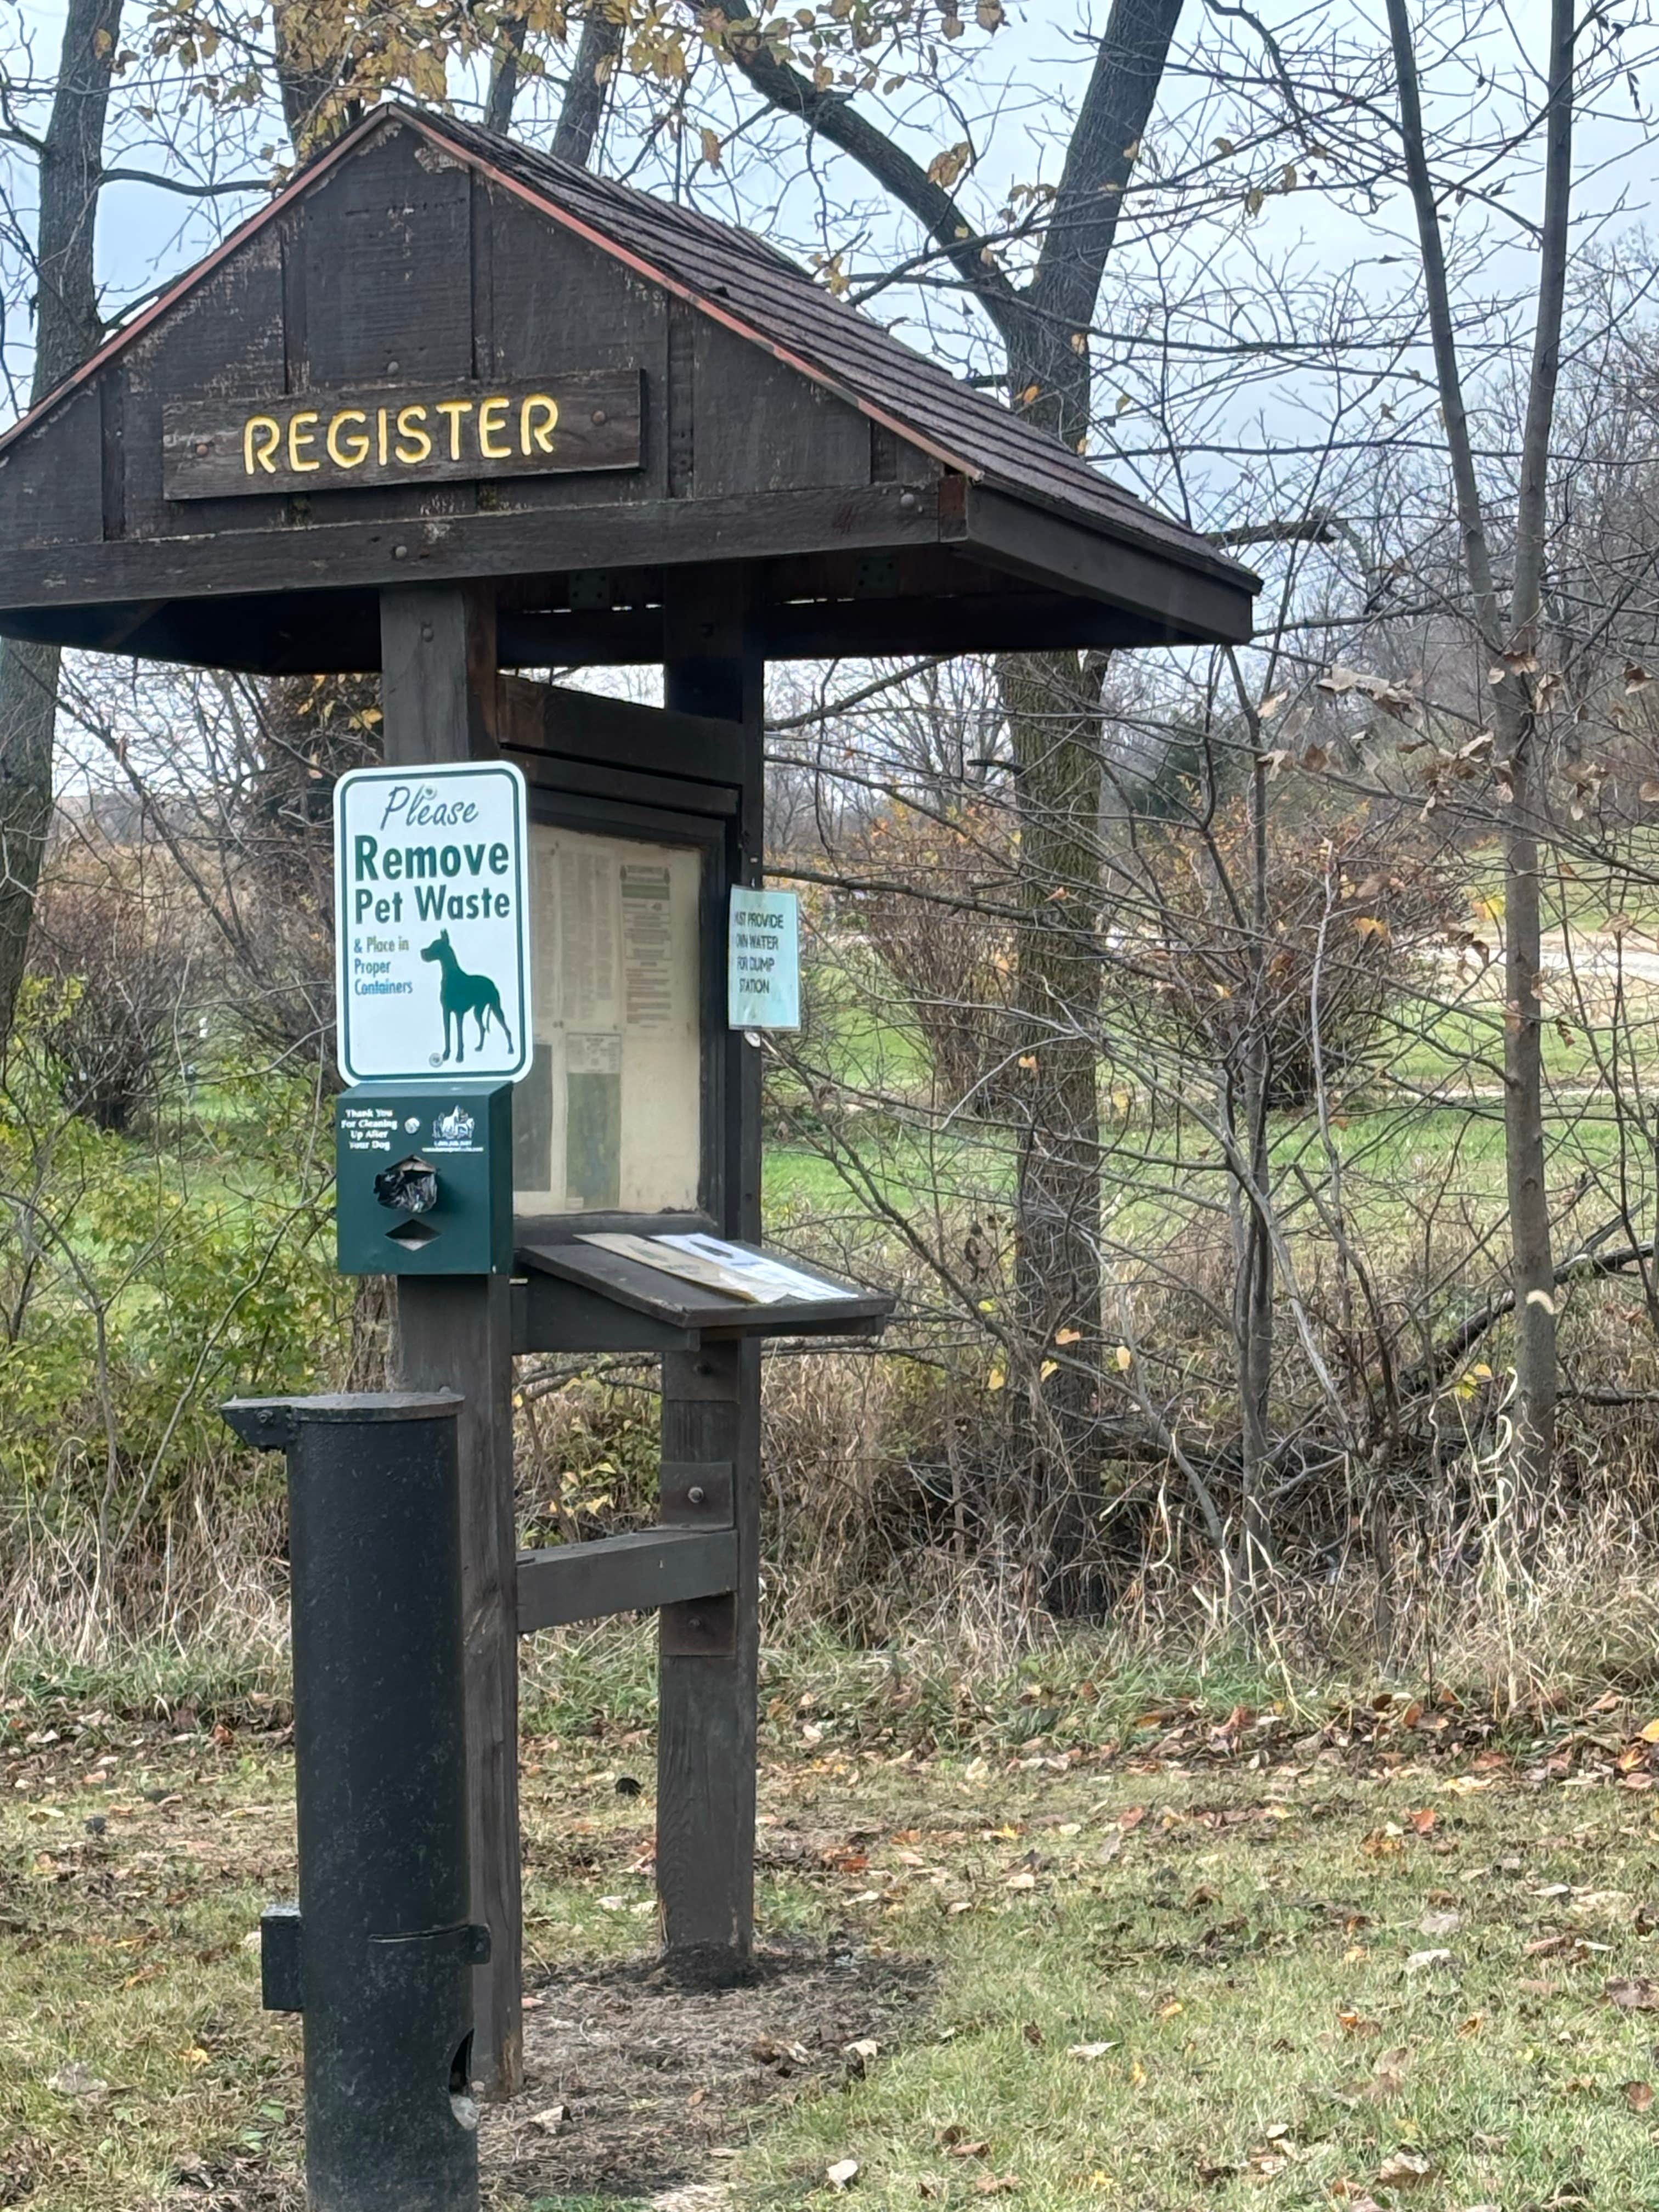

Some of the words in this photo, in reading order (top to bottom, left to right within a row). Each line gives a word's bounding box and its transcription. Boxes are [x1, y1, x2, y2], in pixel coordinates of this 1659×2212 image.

[244, 393, 559, 475] REGISTER
[380, 783, 479, 831] Please
[354, 834, 509, 882] Remove
[355, 888, 403, 924] Pet
[414, 884, 510, 922] Waste
[748, 912, 784, 929] PROVIDE
[354, 938, 363, 953] &
[366, 935, 395, 953] Place
[398, 935, 409, 951] in
[749, 934, 778, 951] WATER
[354, 957, 391, 978] Proper
[749, 956, 775, 973] DUMP
[354, 978, 413, 996] Containers
[739, 978, 770, 994] STATION
[345, 1108, 374, 1118] Thank
[375, 1109, 393, 1118] You
[341, 1119, 357, 1129] For
[358, 1119, 398, 1130] Cleaning
[350, 1130, 364, 1141] Up
[365, 1129, 389, 1139] After
[349, 1141, 370, 1150] Your
[371, 1140, 391, 1151] Dog
